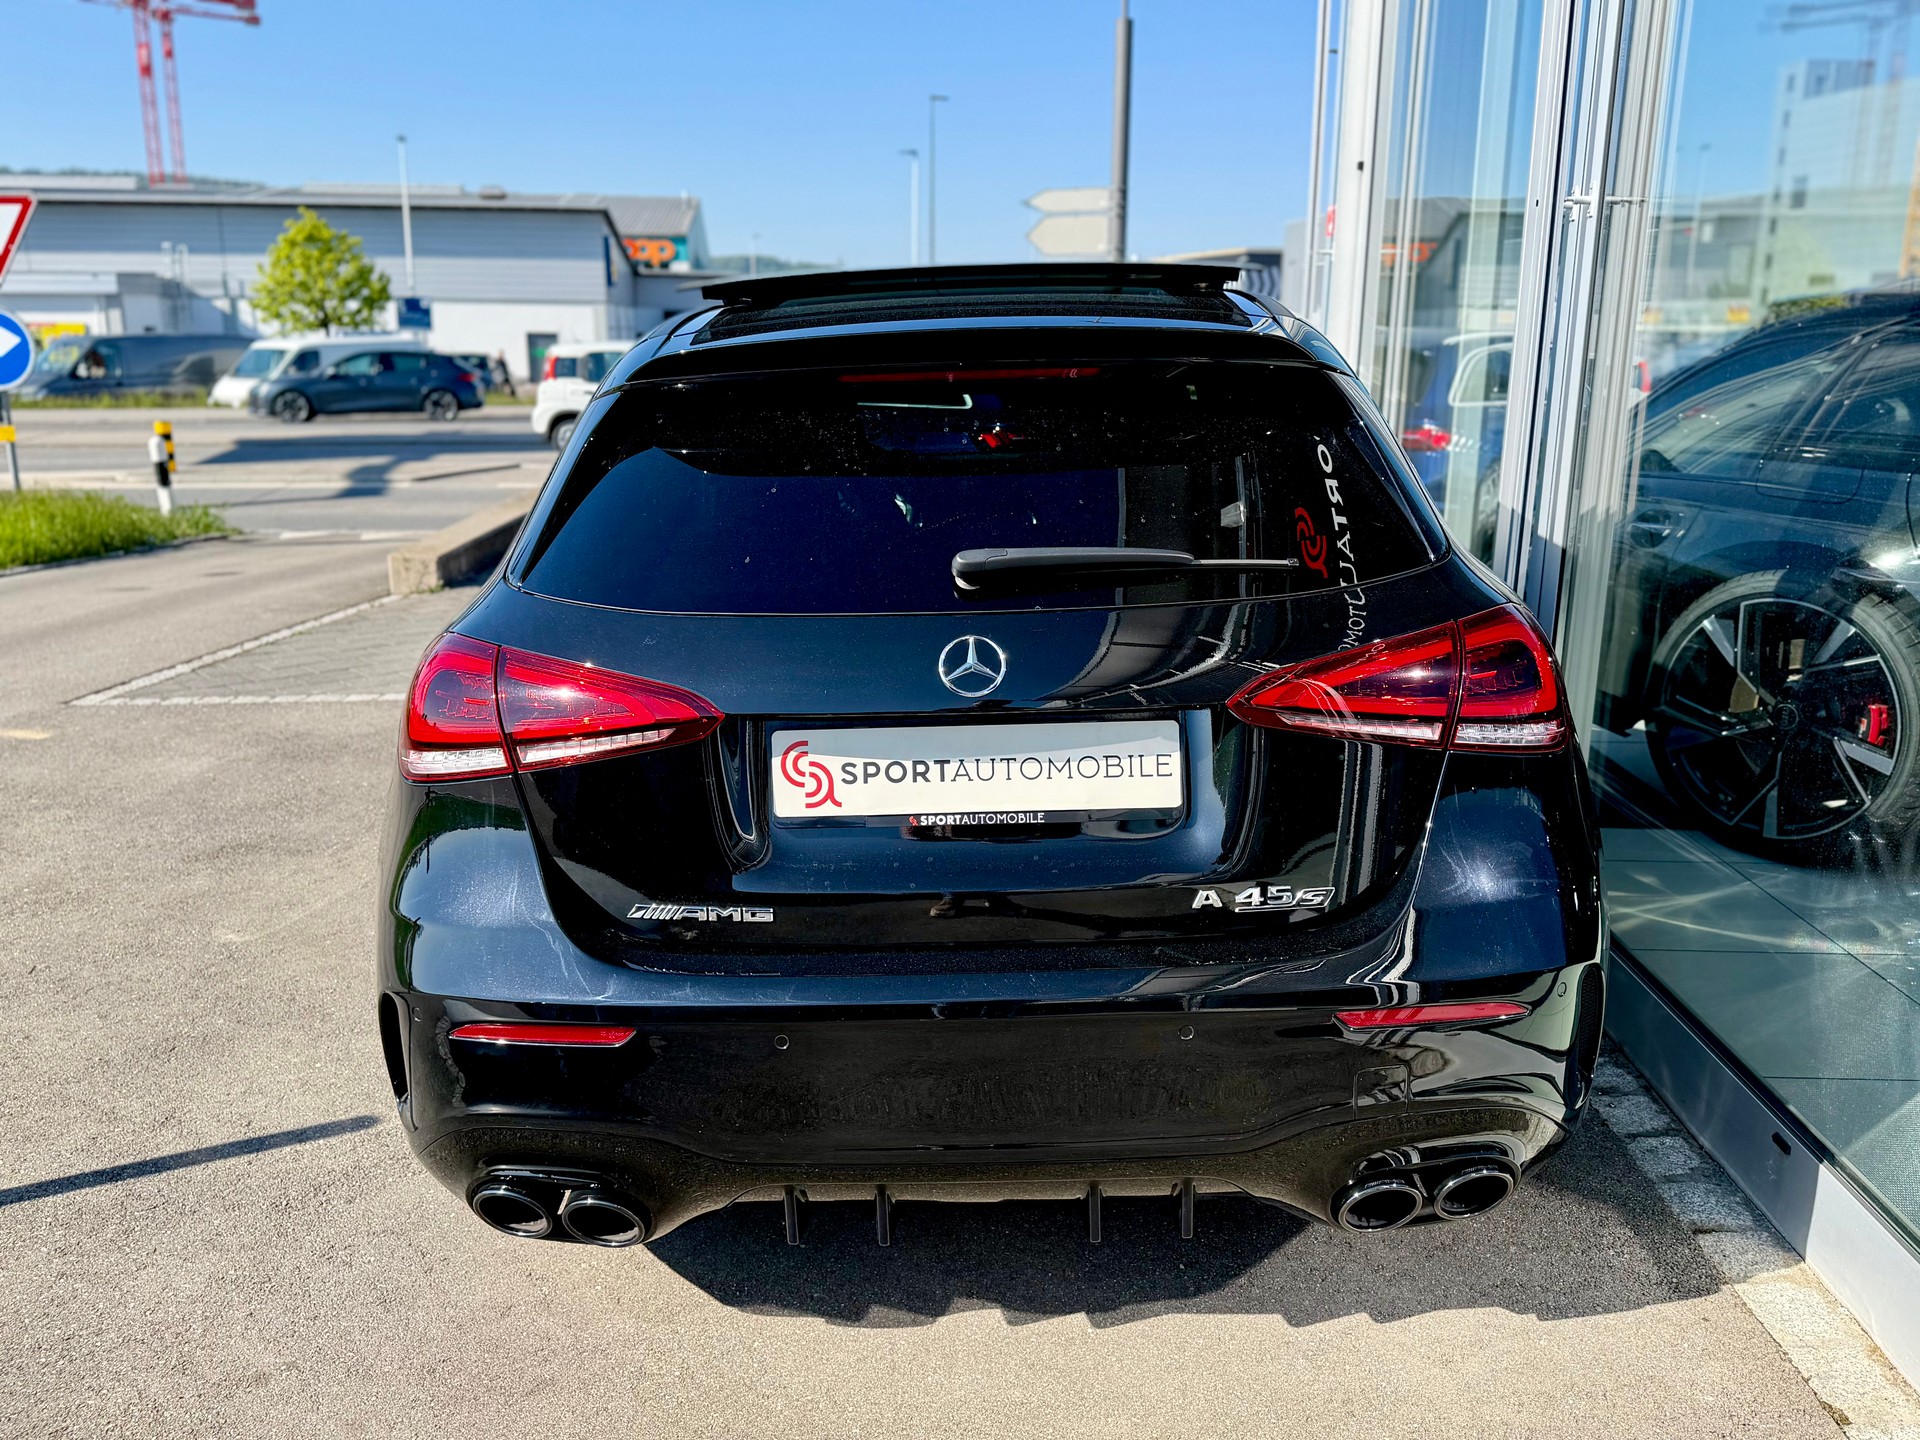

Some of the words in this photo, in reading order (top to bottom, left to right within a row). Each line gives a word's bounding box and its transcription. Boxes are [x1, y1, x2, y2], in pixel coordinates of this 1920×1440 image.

[841, 754, 1172, 785] SPORTAUTOMOBILE
[920, 812, 1045, 826] SPORTAUTOMOBILE
[1191, 889, 1223, 909] A
[672, 905, 774, 922] AMG
